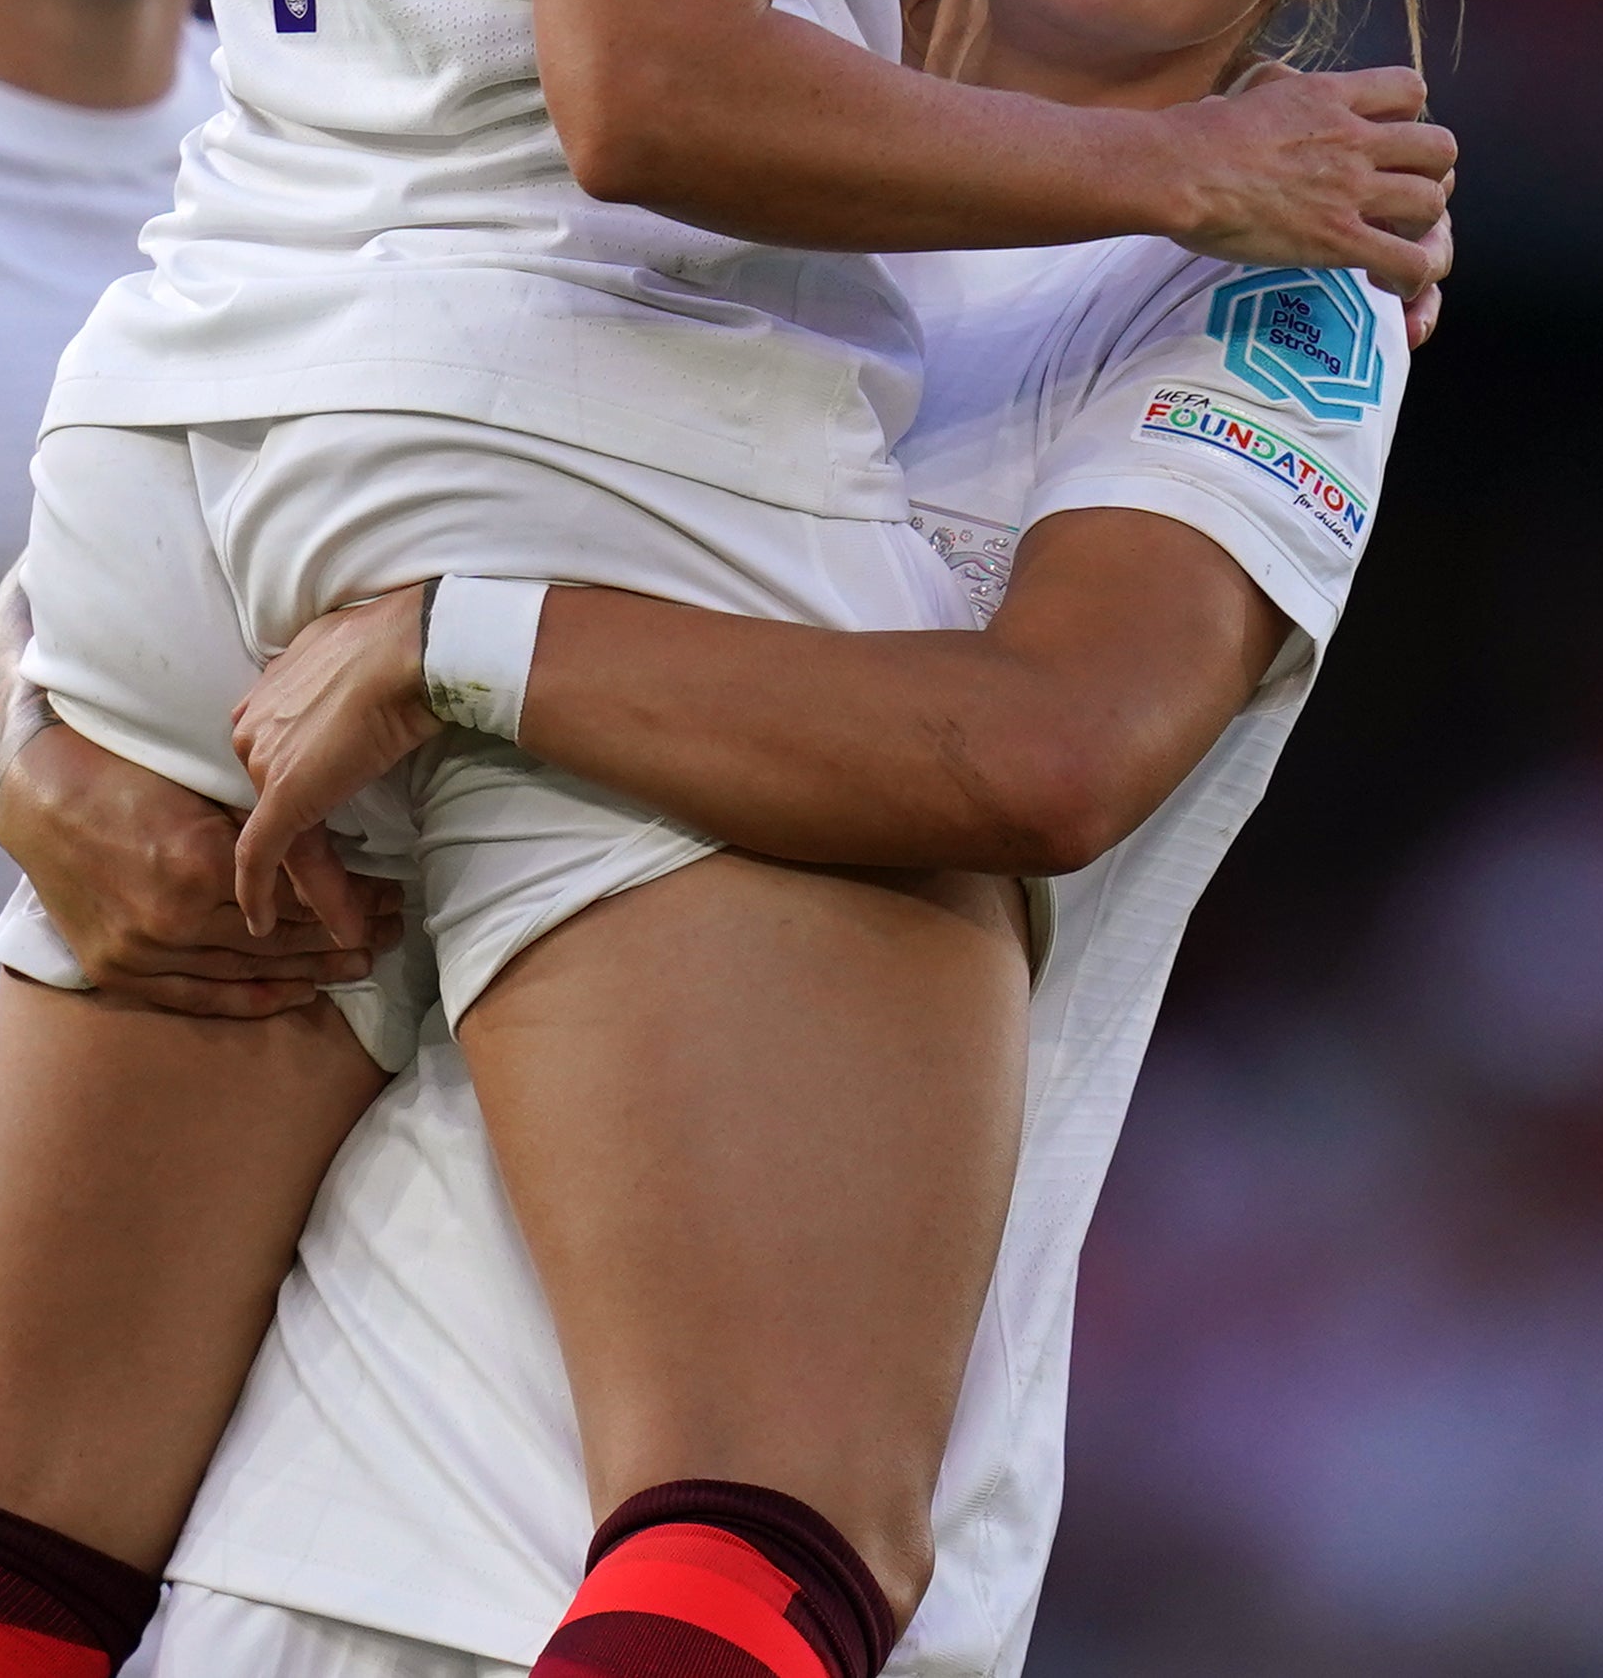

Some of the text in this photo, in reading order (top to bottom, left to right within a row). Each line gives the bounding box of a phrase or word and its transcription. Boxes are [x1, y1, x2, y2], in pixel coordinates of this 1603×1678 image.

[1277, 291, 1311, 315] We
[1272, 309, 1321, 344] Play
[1269, 328, 1342, 376] Strong
[1154, 388, 1211, 408] UEFA
[1293, 493, 1353, 550] for children
